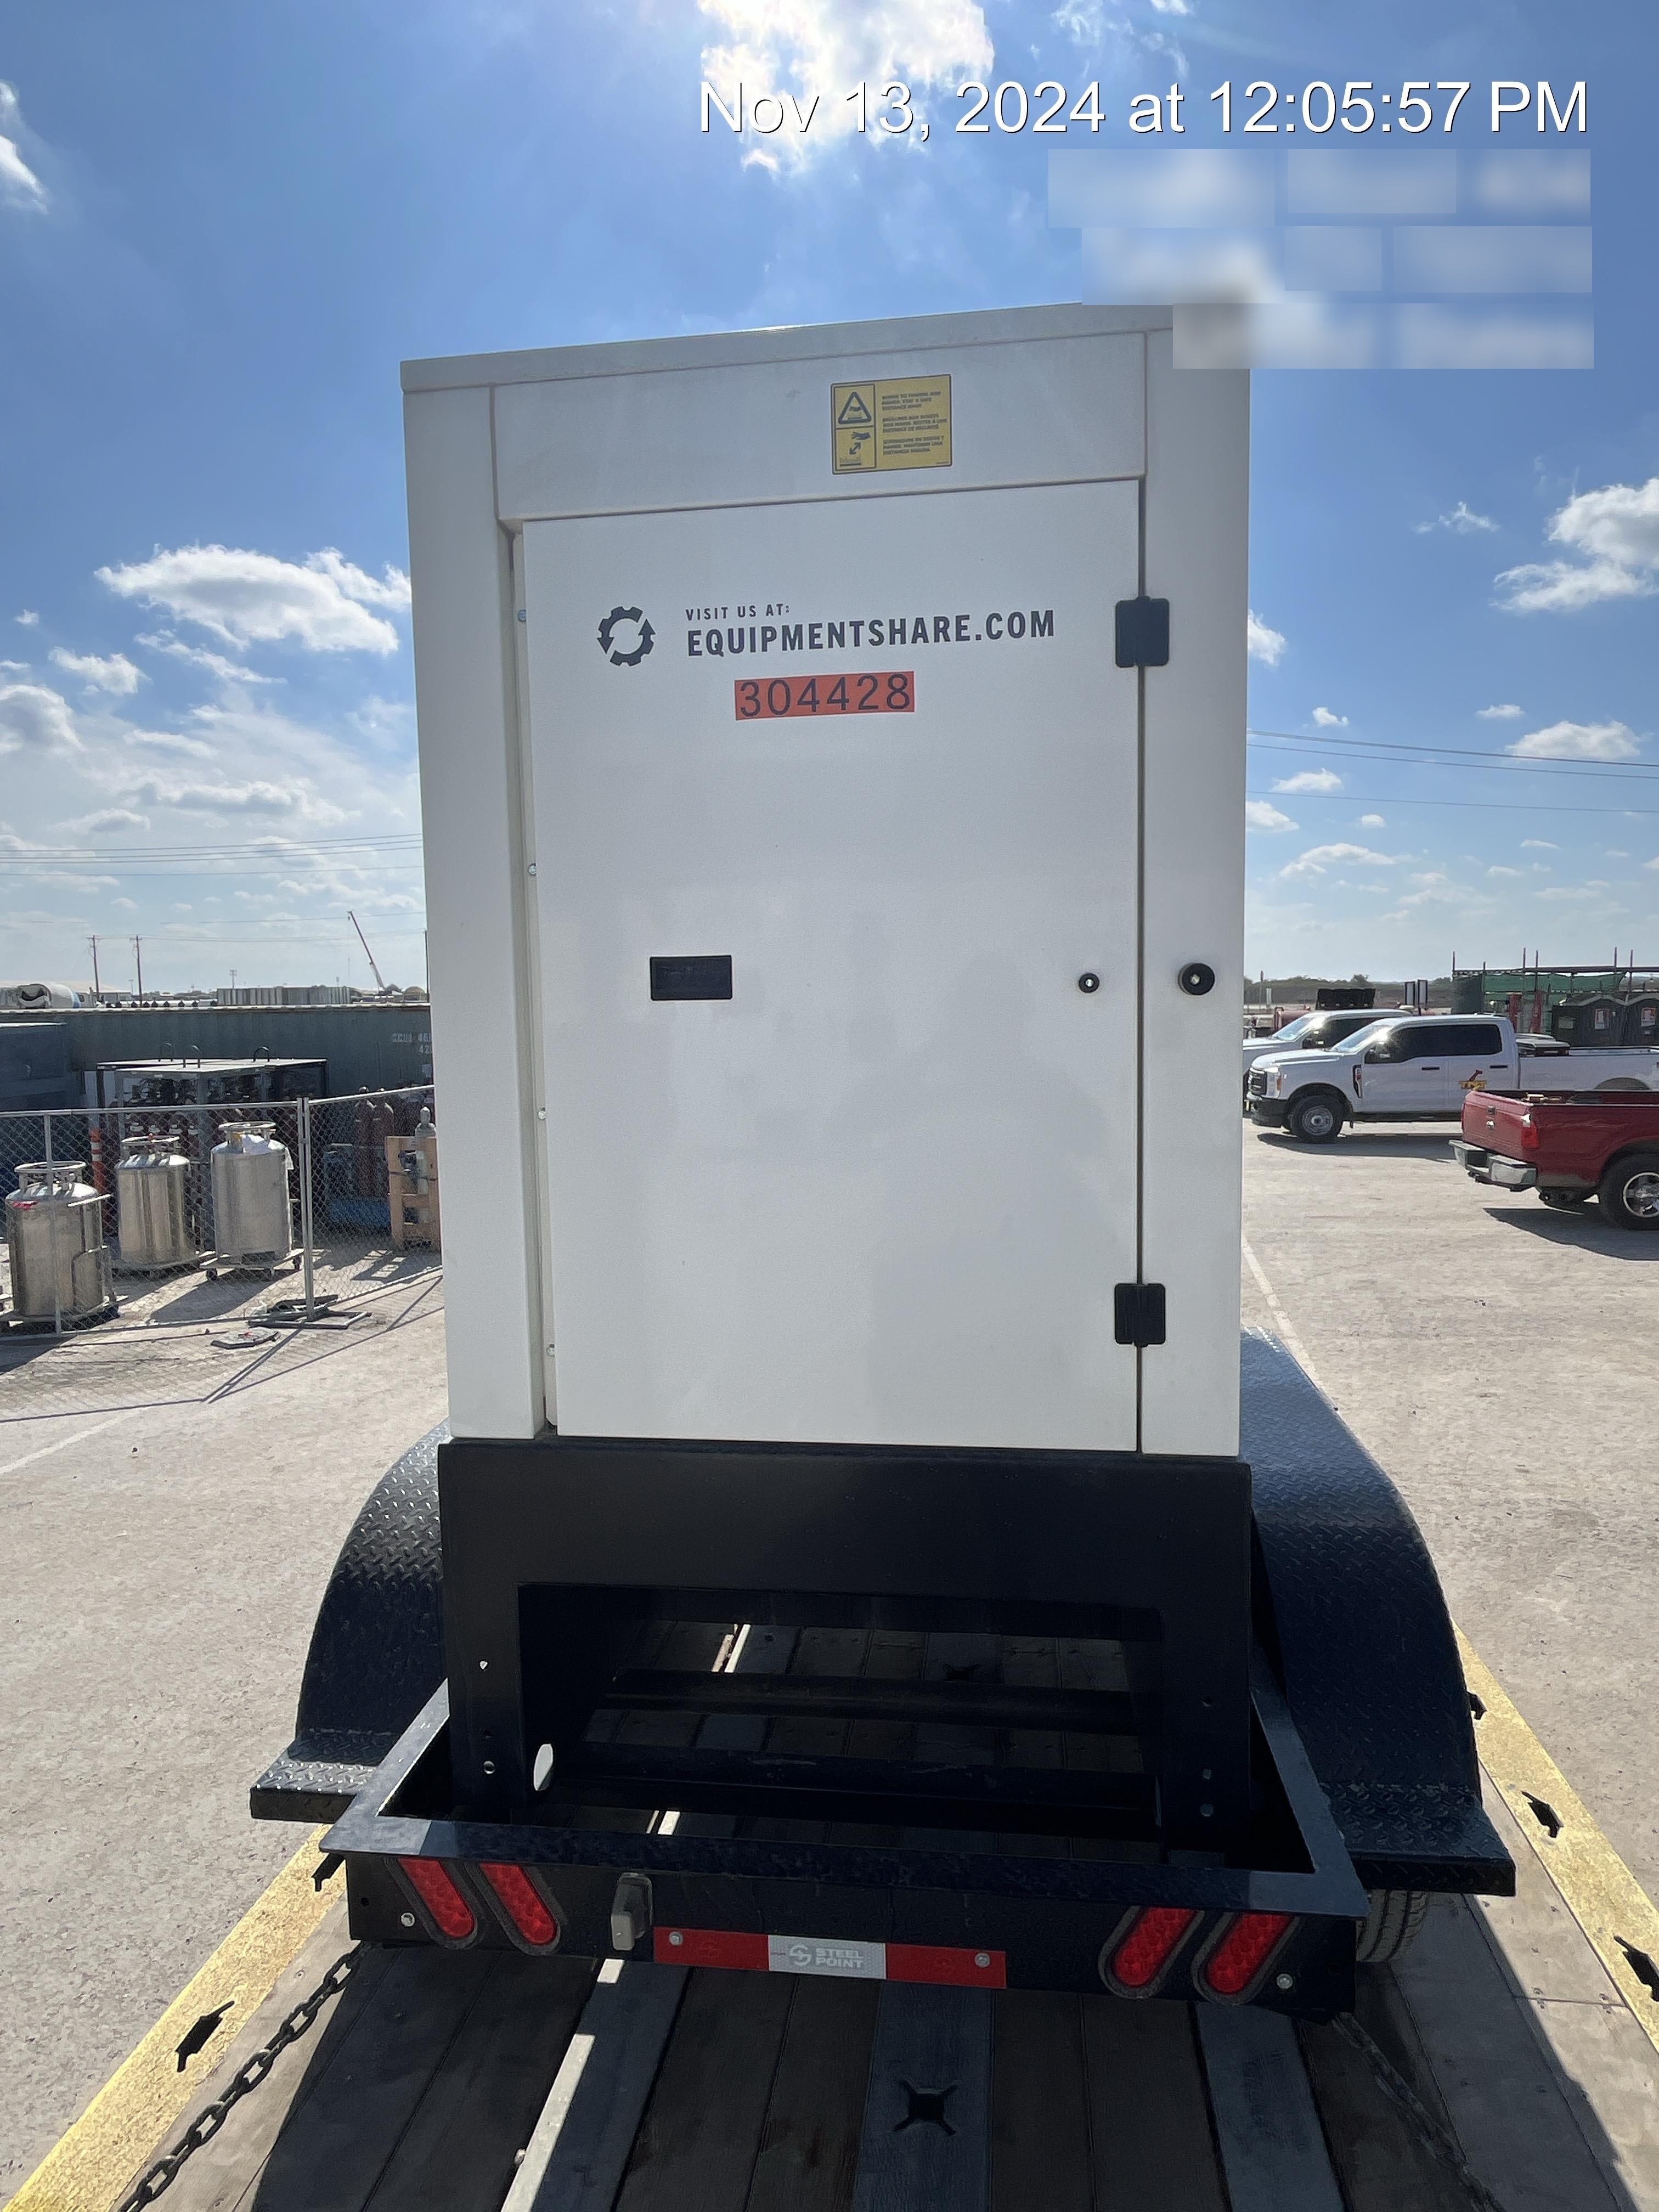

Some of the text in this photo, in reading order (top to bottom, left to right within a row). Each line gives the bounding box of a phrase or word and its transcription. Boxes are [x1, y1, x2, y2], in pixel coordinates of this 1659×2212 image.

[685, 603, 791, 621] VISIT US AT:
[687, 610, 1054, 657] EQUIPMENTSHARE.COM
[740, 673, 911, 717] 304428
[815, 1948, 864, 1959] STEEL
[815, 1957, 864, 1968] POINT
